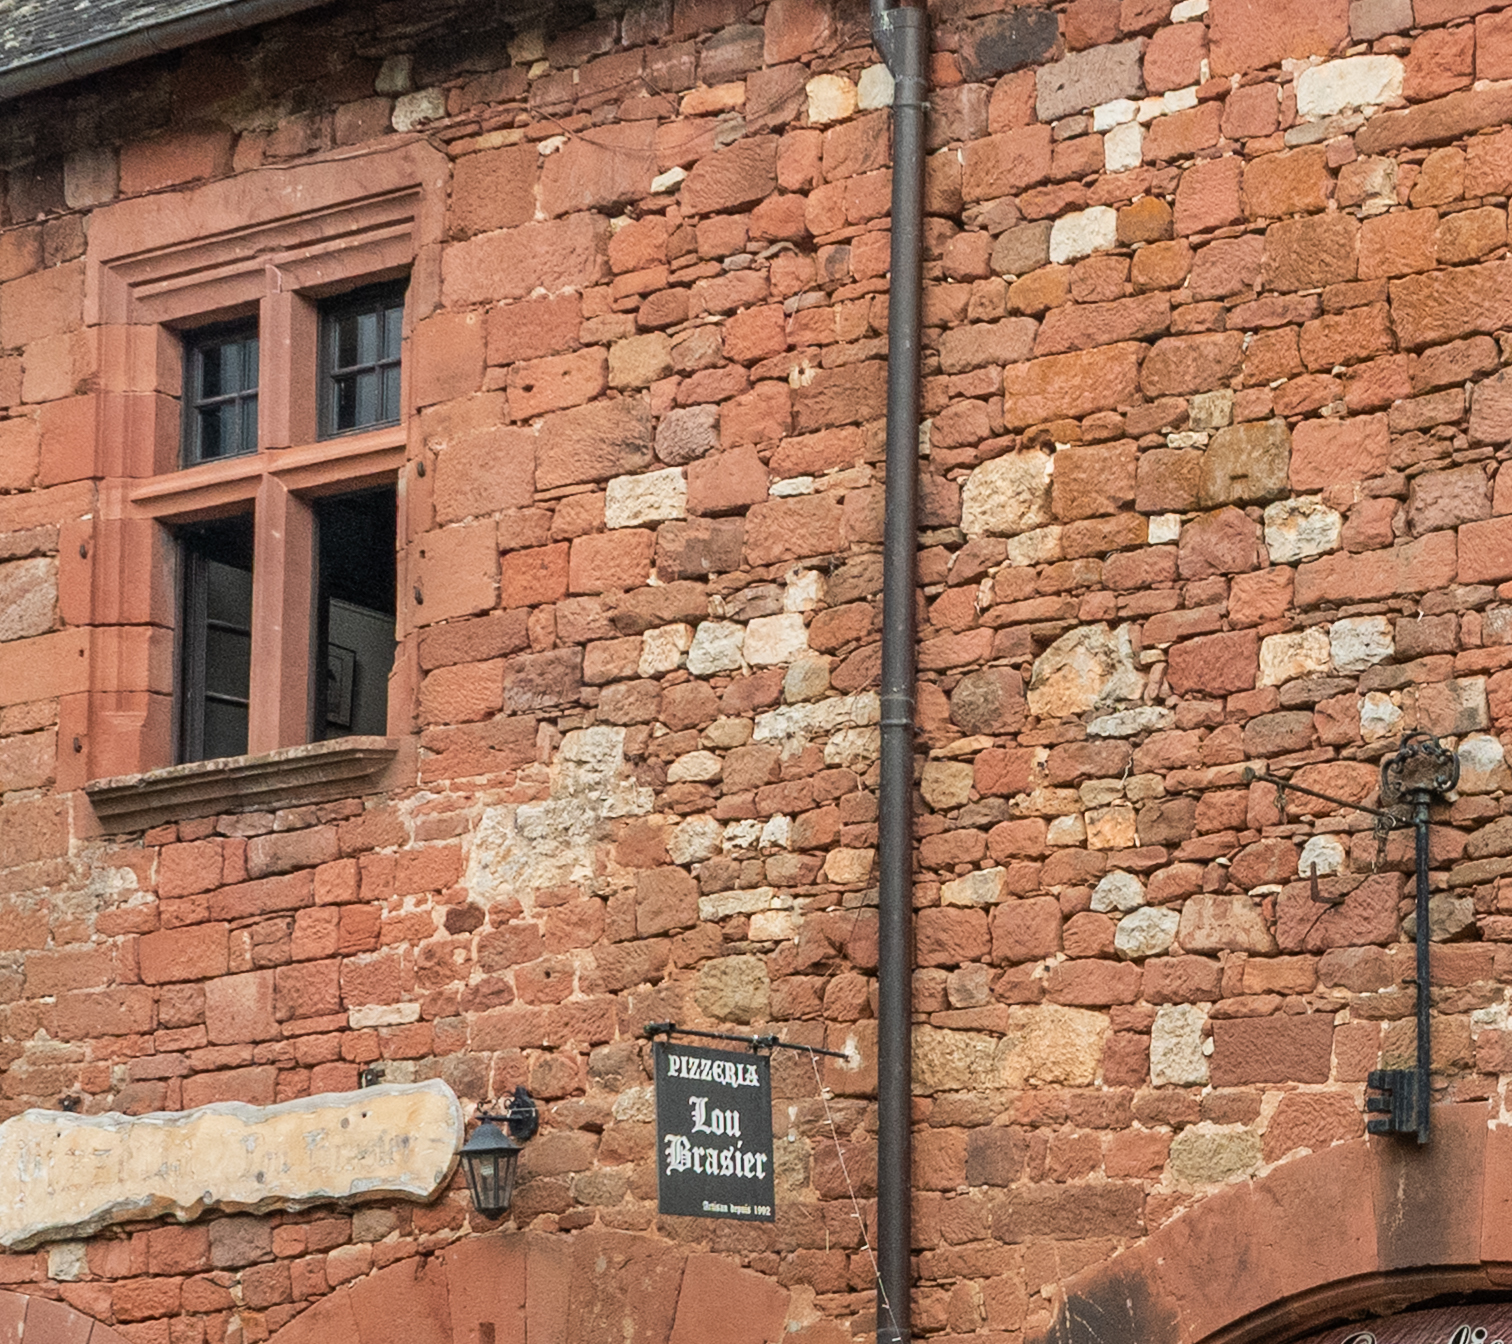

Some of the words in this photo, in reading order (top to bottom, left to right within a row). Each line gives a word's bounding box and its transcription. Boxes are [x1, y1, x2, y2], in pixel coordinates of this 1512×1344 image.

[667, 1054, 760, 1088] PIZZERIA
[689, 1096, 742, 1137] Lou
[664, 1134, 768, 1179] Brasier
